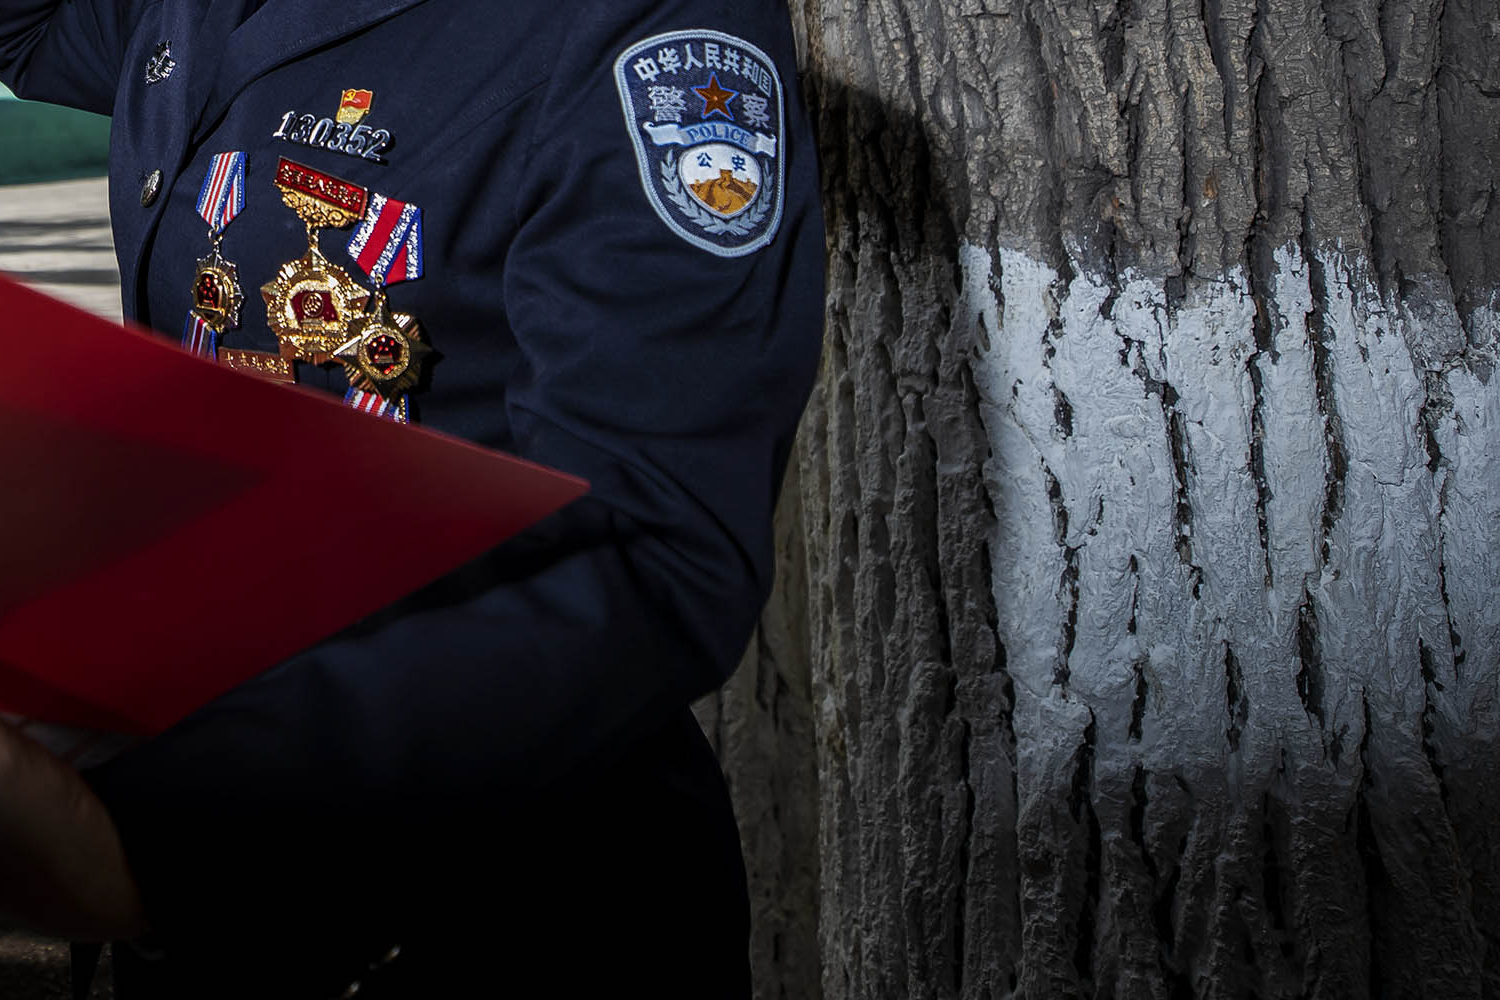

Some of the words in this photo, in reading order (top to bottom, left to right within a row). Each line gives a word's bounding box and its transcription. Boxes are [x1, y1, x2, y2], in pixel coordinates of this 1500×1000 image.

[633, 42, 774, 98] 中华人民共和国
[272, 109, 391, 162] 130352
[686, 124, 751, 147] POLICE
